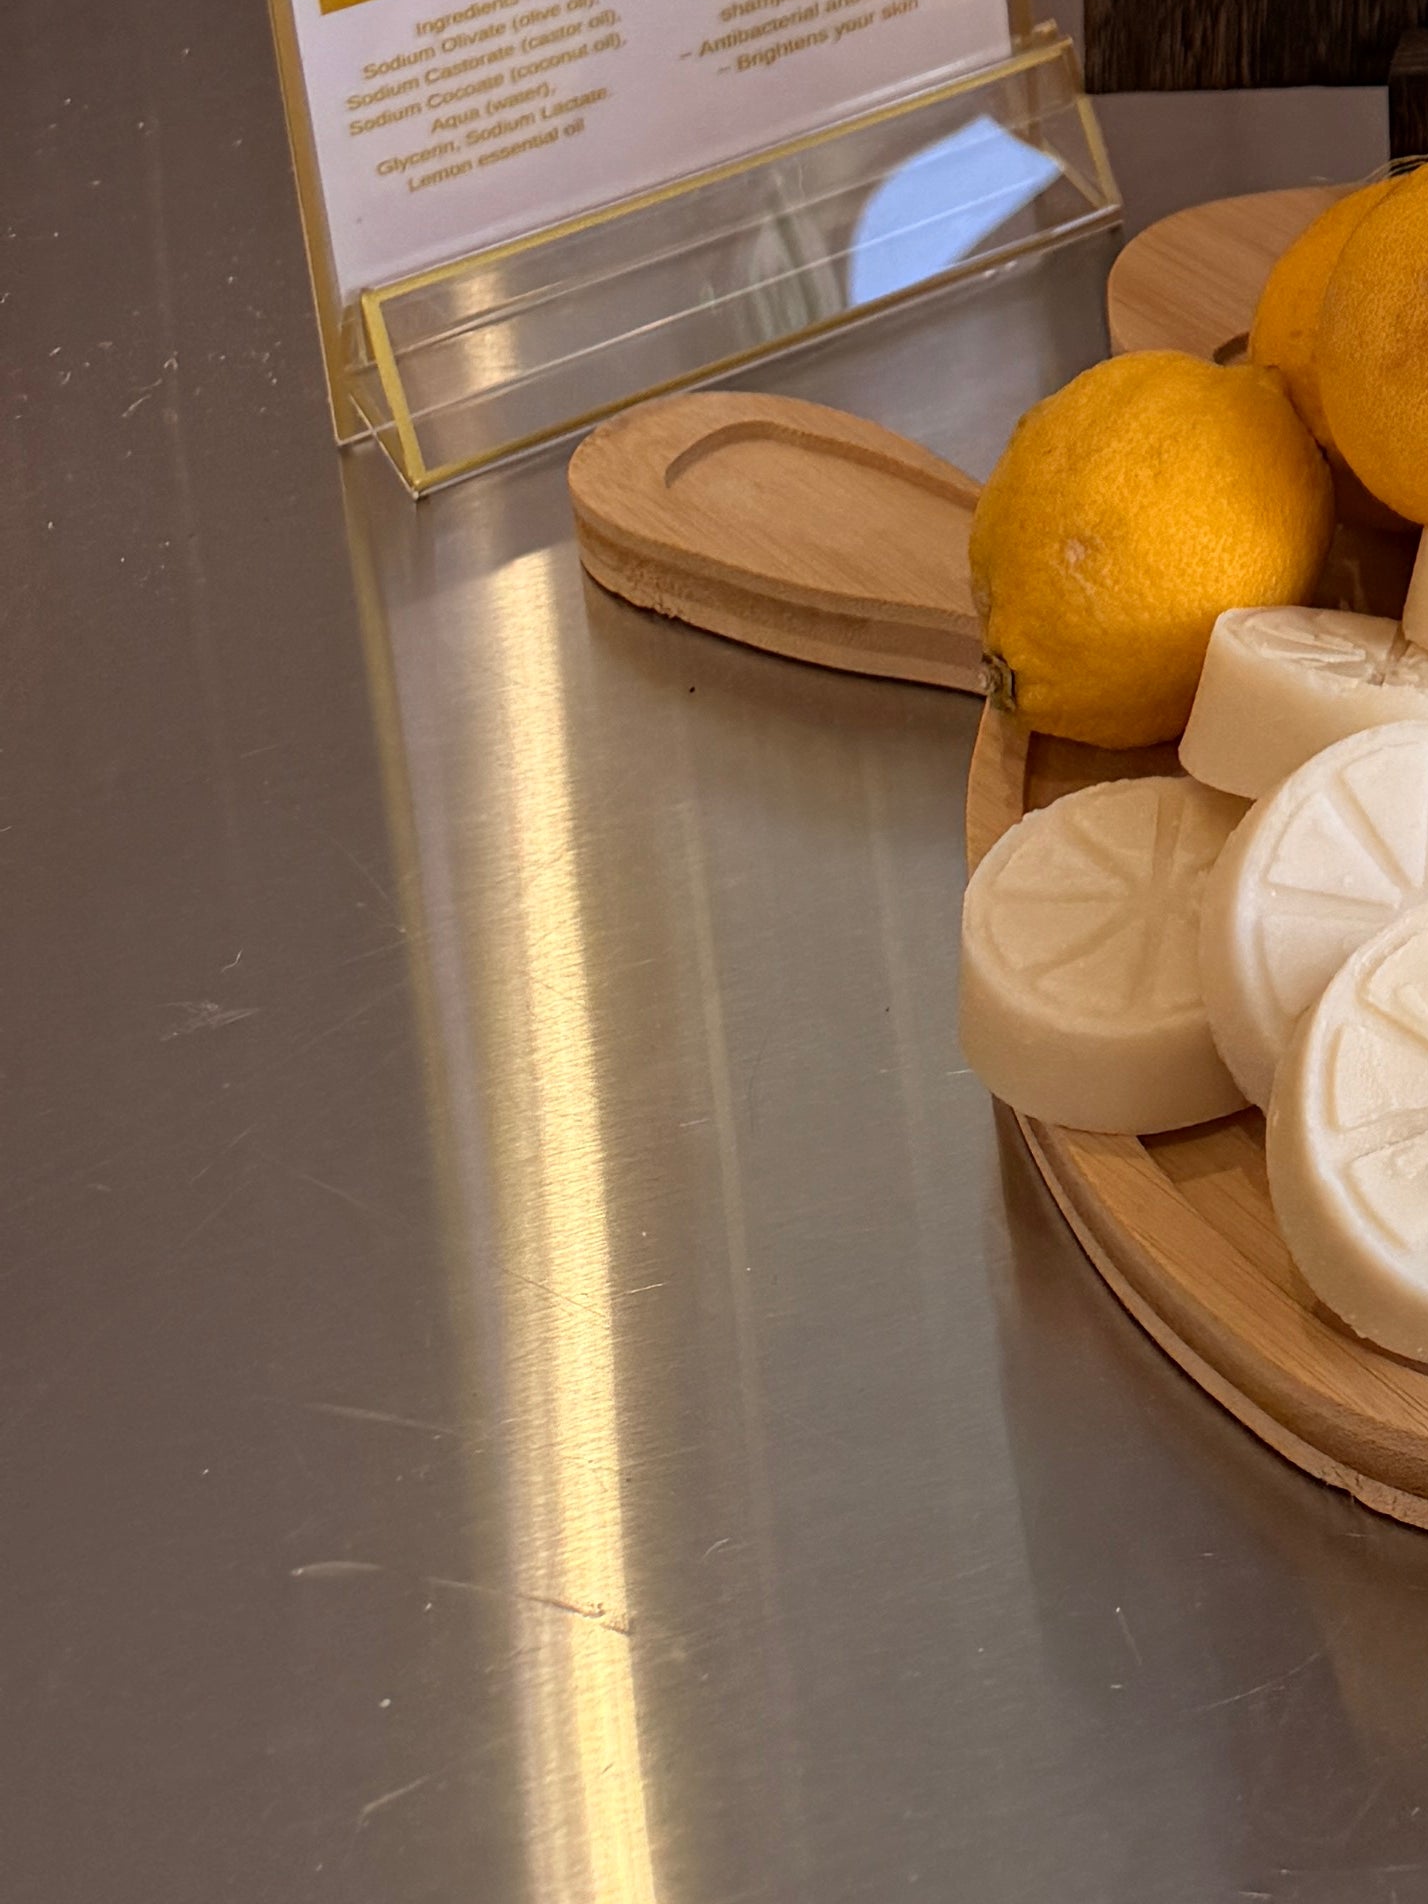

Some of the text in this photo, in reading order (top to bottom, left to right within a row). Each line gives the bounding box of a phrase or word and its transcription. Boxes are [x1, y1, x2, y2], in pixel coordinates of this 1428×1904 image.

[699, 4, 819, 57] Antibacterial
[736, 27, 828, 72] Brightens
[834, 12, 875, 42] your
